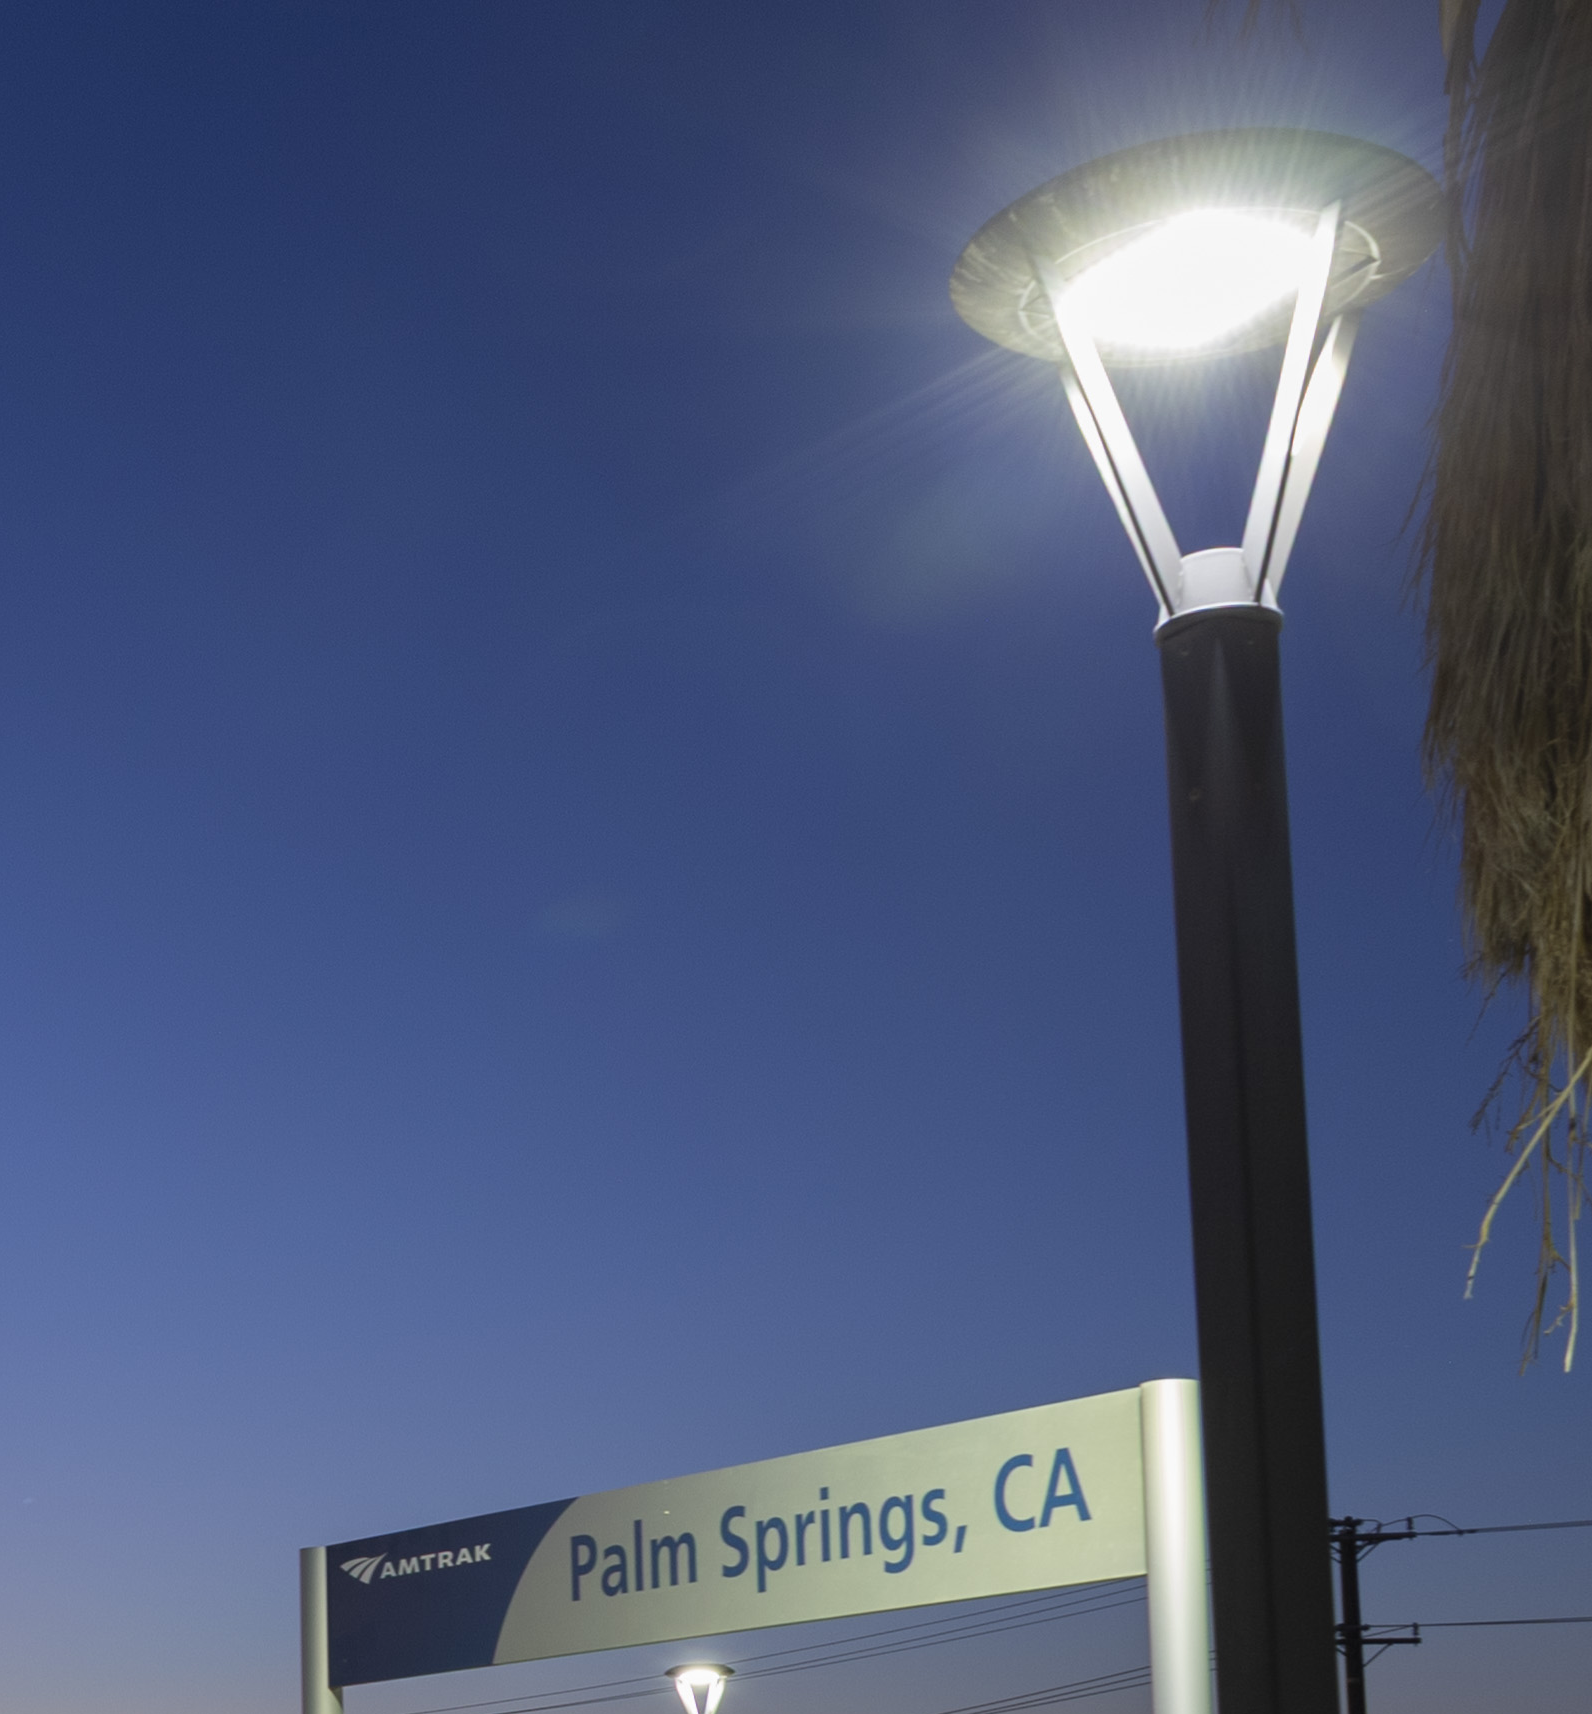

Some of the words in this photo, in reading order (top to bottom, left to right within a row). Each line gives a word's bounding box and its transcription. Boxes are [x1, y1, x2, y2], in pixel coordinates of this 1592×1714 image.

[380, 1543, 492, 1579] AMTRAK
[570, 1519, 698, 1601] Palm
[720, 1486, 968, 1593] Springs,
[993, 1447, 1092, 1533] CA
